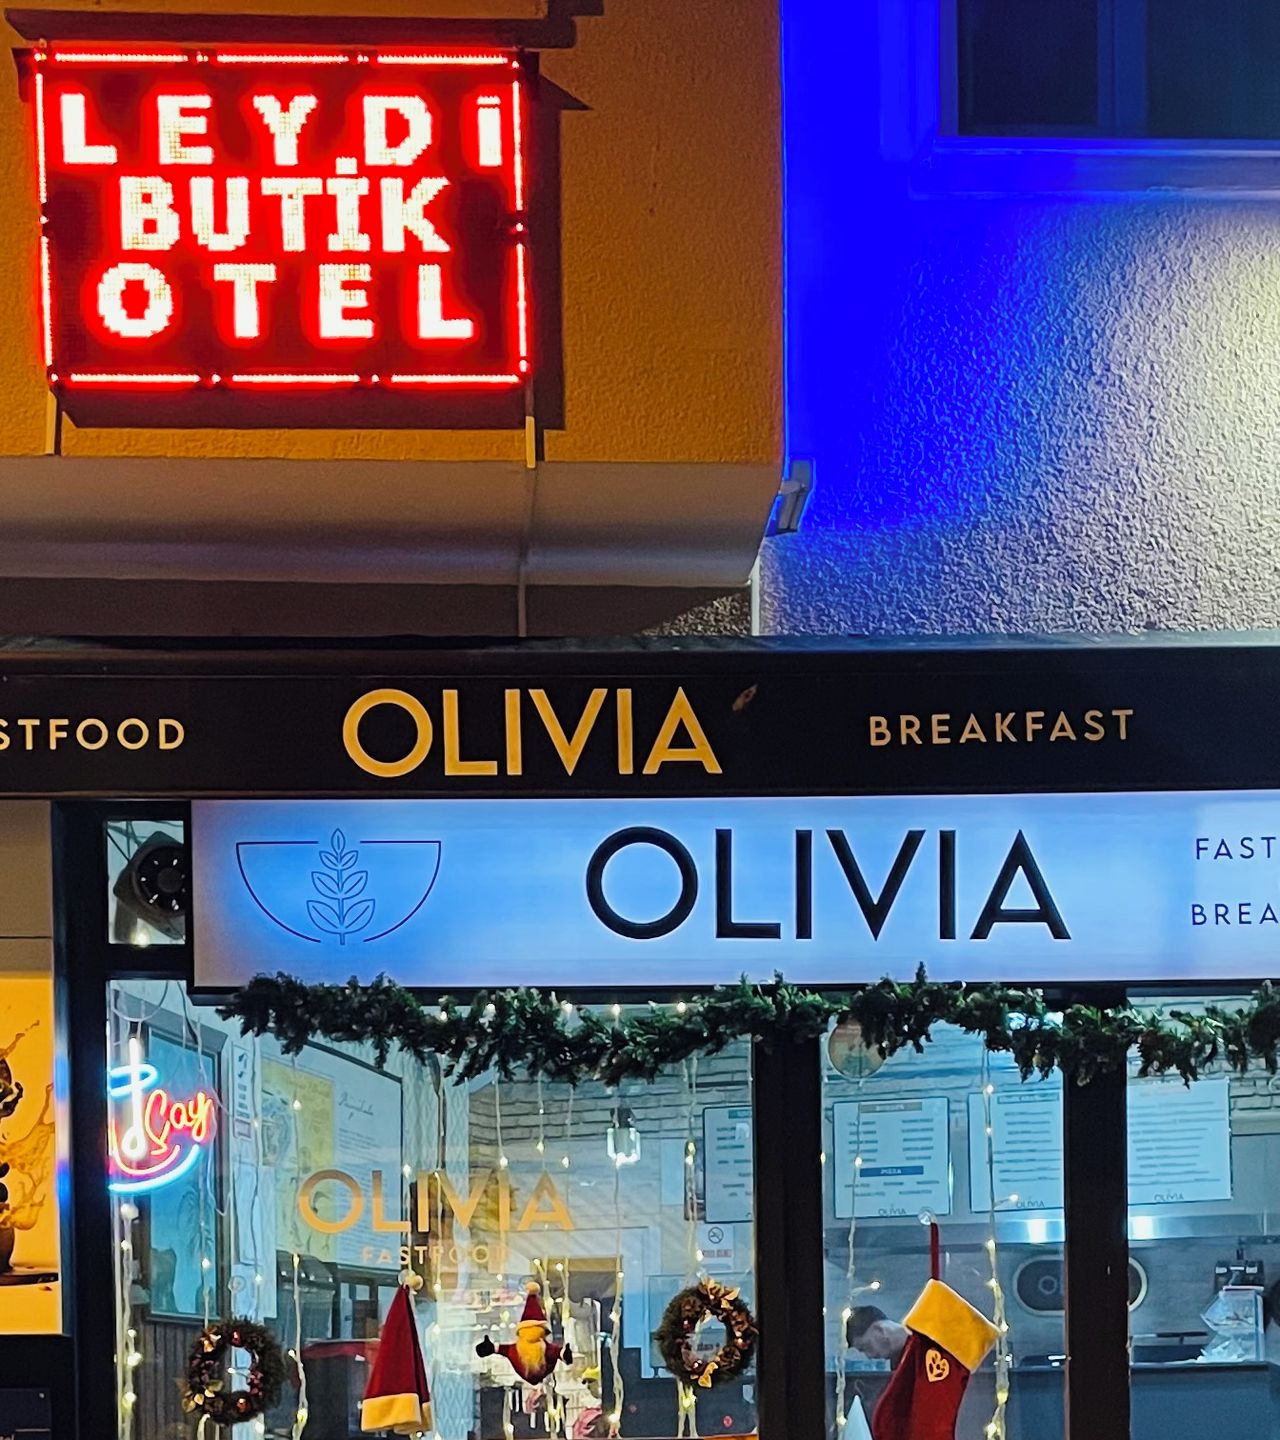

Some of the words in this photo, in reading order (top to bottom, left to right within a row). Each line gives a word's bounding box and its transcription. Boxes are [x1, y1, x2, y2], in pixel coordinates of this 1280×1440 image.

[119, 156, 451, 253] BUTİK
[96, 262, 475, 339] OTEL
[342, 686, 723, 778] OLIVIA
[868, 708, 1136, 748] BREAKFAST
[585, 826, 1072, 942] OLIVIA
[297, 1168, 574, 1233] OLIVIA
